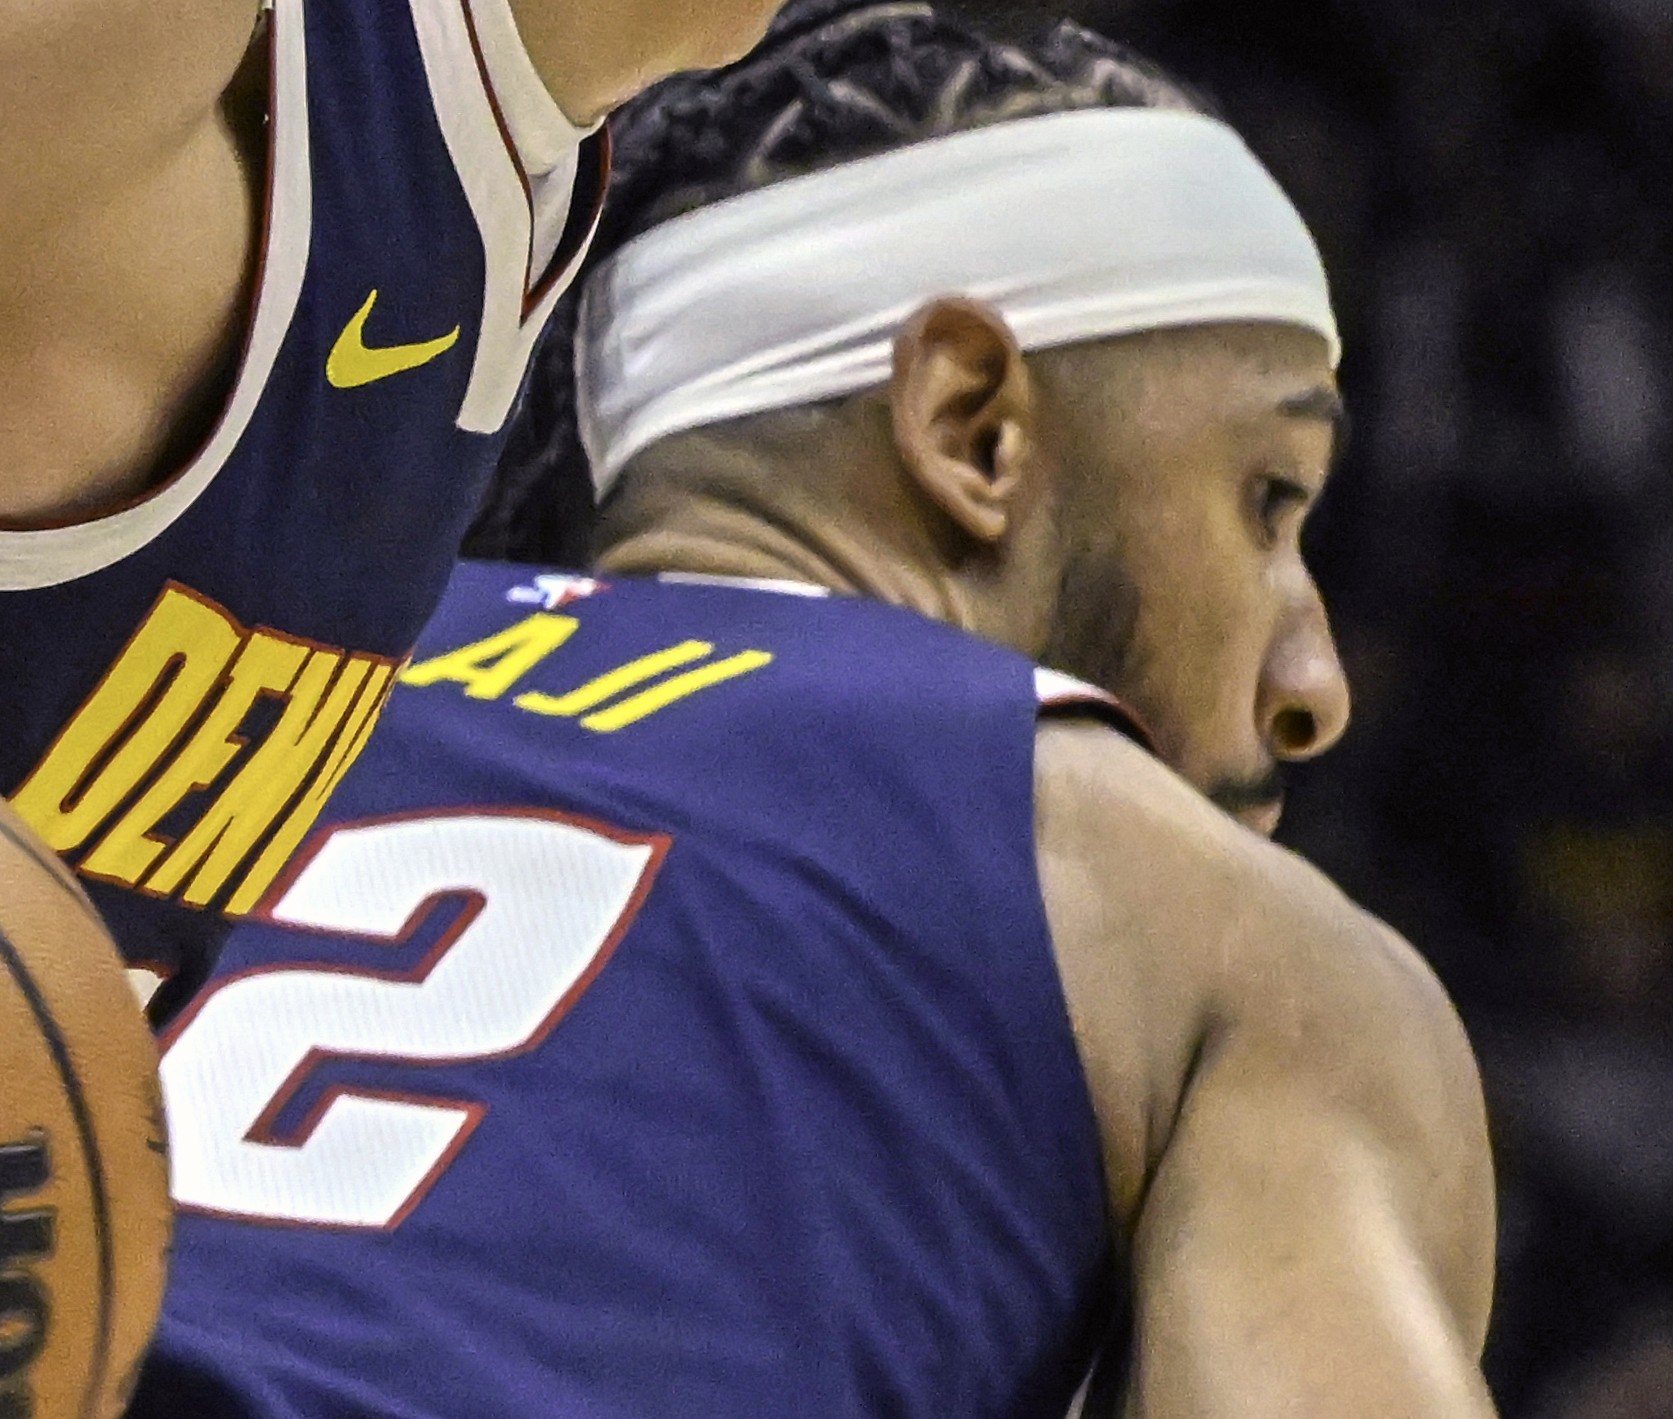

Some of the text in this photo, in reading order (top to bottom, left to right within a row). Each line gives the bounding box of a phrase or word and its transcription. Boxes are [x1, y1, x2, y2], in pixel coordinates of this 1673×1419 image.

[10, 578, 412, 922] DENV
[397, 612, 773, 732] AJI
[155, 805, 673, 1231] 2
